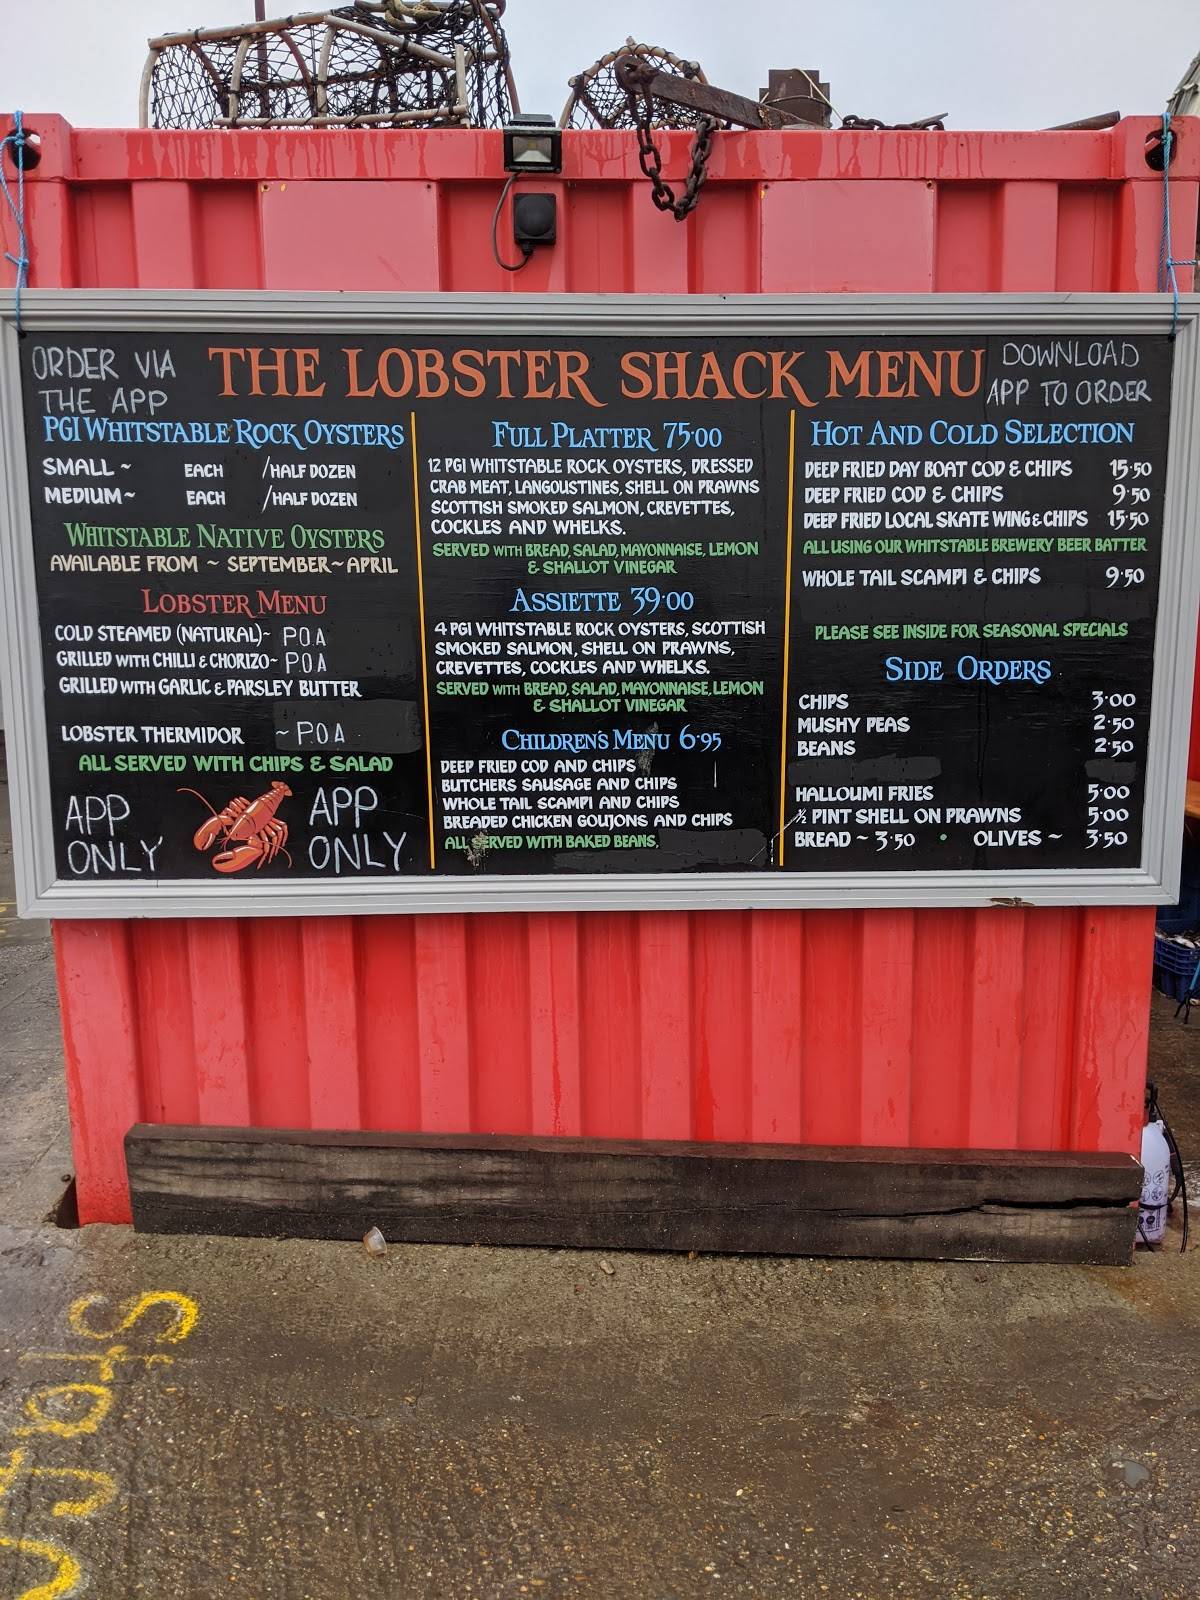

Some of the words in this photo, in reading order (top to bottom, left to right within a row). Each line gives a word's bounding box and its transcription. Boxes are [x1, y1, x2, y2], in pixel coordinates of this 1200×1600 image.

[1003, 340, 1139, 367] DOWNLOAD
[32, 347, 118, 380] ORDER
[135, 350, 176, 378] VIA
[209, 348, 325, 396] THE
[346, 348, 608, 408] LOBSTER
[621, 352, 817, 407] SHACK
[826, 350, 985, 397] MENU
[987, 378, 1029, 405] APP
[1041, 381, 1067, 406] TO
[1076, 379, 1152, 405] ORDER
[39, 387, 96, 414] THE
[112, 388, 167, 415] APP
[43, 416, 81, 441] PGI
[43, 458, 114, 476] SMALL
[185, 464, 223, 477] EACH
[310, 465, 356, 478] DOZEN
[428, 458, 441, 472] 12
[445, 458, 466, 473] PGI
[470, 458, 562, 473] WHITSTABLE
[567, 459, 610, 474] ROCK
[692, 458, 753, 474] DRESSED
[805, 462, 839, 478] DEEP
[843, 461, 885, 478] FRIED
[890, 461, 920, 477] DAY
[925, 461, 967, 477] BOAT
[972, 461, 1005, 477] COD
[1025, 460, 1072, 476] CHIPS
[430, 480, 466, 494] CRAB
[625, 480, 669, 494] SHELL
[673, 480, 693, 494] ON
[699, 480, 759, 494] PRAWNS
[431, 500, 502, 514] SCOTTISH
[508, 501, 568, 515] SMOKED
[431, 519, 502, 534] COCKLES
[509, 520, 546, 534] AND
[433, 543, 489, 556] SERVED
[493, 546, 522, 556] WITH
[709, 542, 758, 556] LEMON
[803, 540, 829, 554] ALL
[831, 540, 872, 553] USING
[875, 540, 903, 553] OUR
[905, 539, 989, 552] WHITSTABLE
[992, 538, 1054, 552] BREWERY
[1058, 538, 1091, 552] BEER
[1095, 538, 1147, 551] BATTER
[543, 561, 609, 574] SHALLOT
[614, 560, 677, 574] VINEGAR
[802, 570, 854, 587] WHOLE
[859, 570, 896, 586] TAIL
[901, 569, 966, 585] SCAMPI
[992, 568, 1041, 584] CHIPS
[55, 625, 93, 641] COLD
[98, 626, 171, 642] STEAMED
[435, 622, 447, 635] 4
[450, 622, 471, 636] PGI
[476, 622, 571, 636] WHITSTABLE
[576, 622, 615, 636] ROCK
[692, 621, 765, 635] SCOTTISH
[816, 625, 868, 640] PLEASE
[873, 625, 899, 639] SEE
[903, 624, 947, 639] INSIDE
[951, 624, 980, 638] FOR
[983, 623, 1059, 637] SEASONAL
[1063, 623, 1128, 636] SPECIALS
[59, 677, 117, 693] GRILLED
[120, 681, 155, 694] WITH
[159, 678, 211, 695] GARLIC
[227, 680, 293, 696] PARSLEY
[299, 680, 362, 697] BUTTER
[799, 694, 848, 709] CHIPS
[798, 717, 860, 733] MUSHY
[867, 717, 910, 732] PEAS
[62, 726, 138, 742] LOBSTER
[141, 727, 245, 744] THERMIDOR
[798, 740, 855, 756] BEANS
[79, 755, 111, 771] ALL
[115, 755, 186, 771] SERVED
[193, 756, 244, 771] WITH
[250, 756, 304, 771] CHIPS
[330, 756, 393, 771] SALAD
[441, 761, 474, 773] DEEP
[479, 760, 517, 773] FRIED
[521, 760, 548, 773] COD
[554, 760, 587, 772] AND
[592, 759, 636, 772] CHIPS
[796, 786, 882, 801] HALLOUMI
[889, 786, 933, 801] FRIES
[66, 794, 130, 836] APP
[310, 786, 377, 828] APP
[444, 816, 508, 829] BREADED
[512, 815, 572, 828] CHICKEN
[577, 814, 648, 830] GOUJONS
[654, 814, 686, 826] AND
[692, 813, 732, 826] CHIPS
[795, 832, 851, 847] BREAD
[974, 830, 1041, 846] OLIVES
[68, 836, 162, 874] ONLY
[309, 832, 406, 873] ONLY
